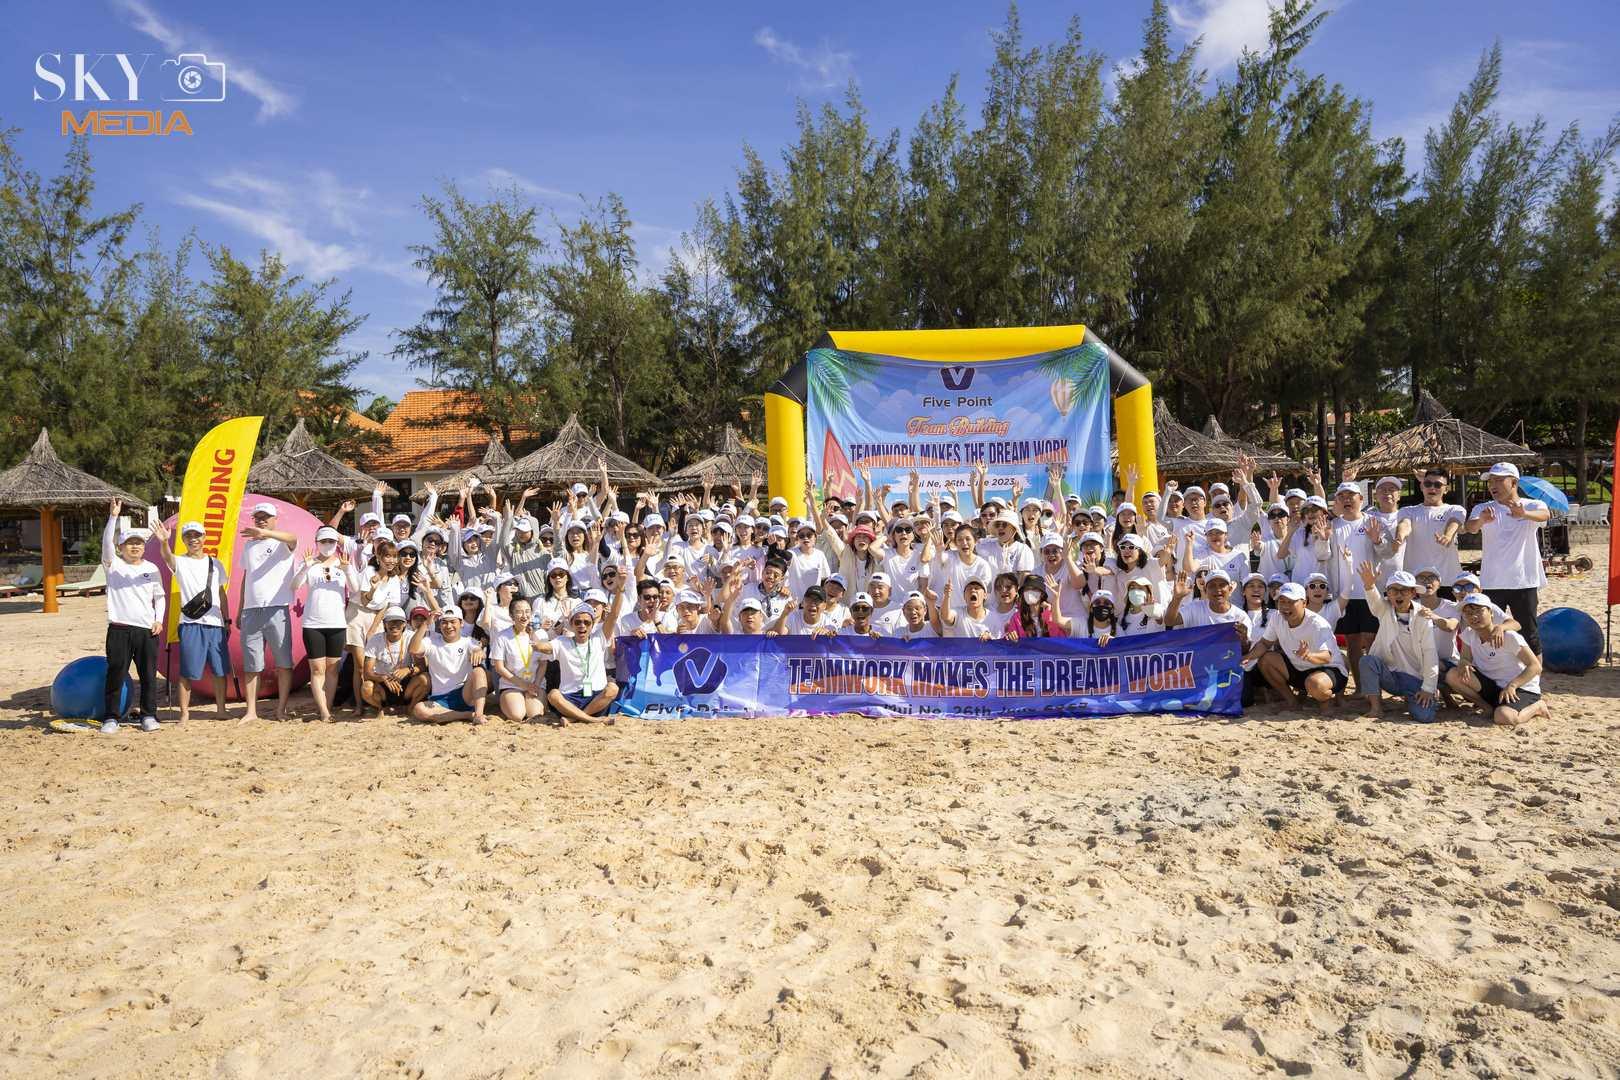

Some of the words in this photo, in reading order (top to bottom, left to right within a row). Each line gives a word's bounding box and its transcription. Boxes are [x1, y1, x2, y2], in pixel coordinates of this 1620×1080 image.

[922, 396, 951, 407] Five
[957, 396, 992, 407] Point
[906, 416, 947, 436] Team
[948, 416, 1010, 436] Building
[849, 443, 916, 468] TEAMWORK
[920, 443, 961, 467] MAKES
[964, 442, 985, 466] THE
[989, 441, 1029, 465] DREAM
[1033, 439, 1069, 464] WORK
[926, 480, 941, 488] Ne,
[991, 477, 1015, 486] 2023
[787, 657, 908, 697] TEAMWORK
[912, 658, 990, 698] MAKES
[993, 657, 1036, 698] THE
[1040, 656, 1121, 698] DREAM
[1124, 650, 1197, 694] WORK
